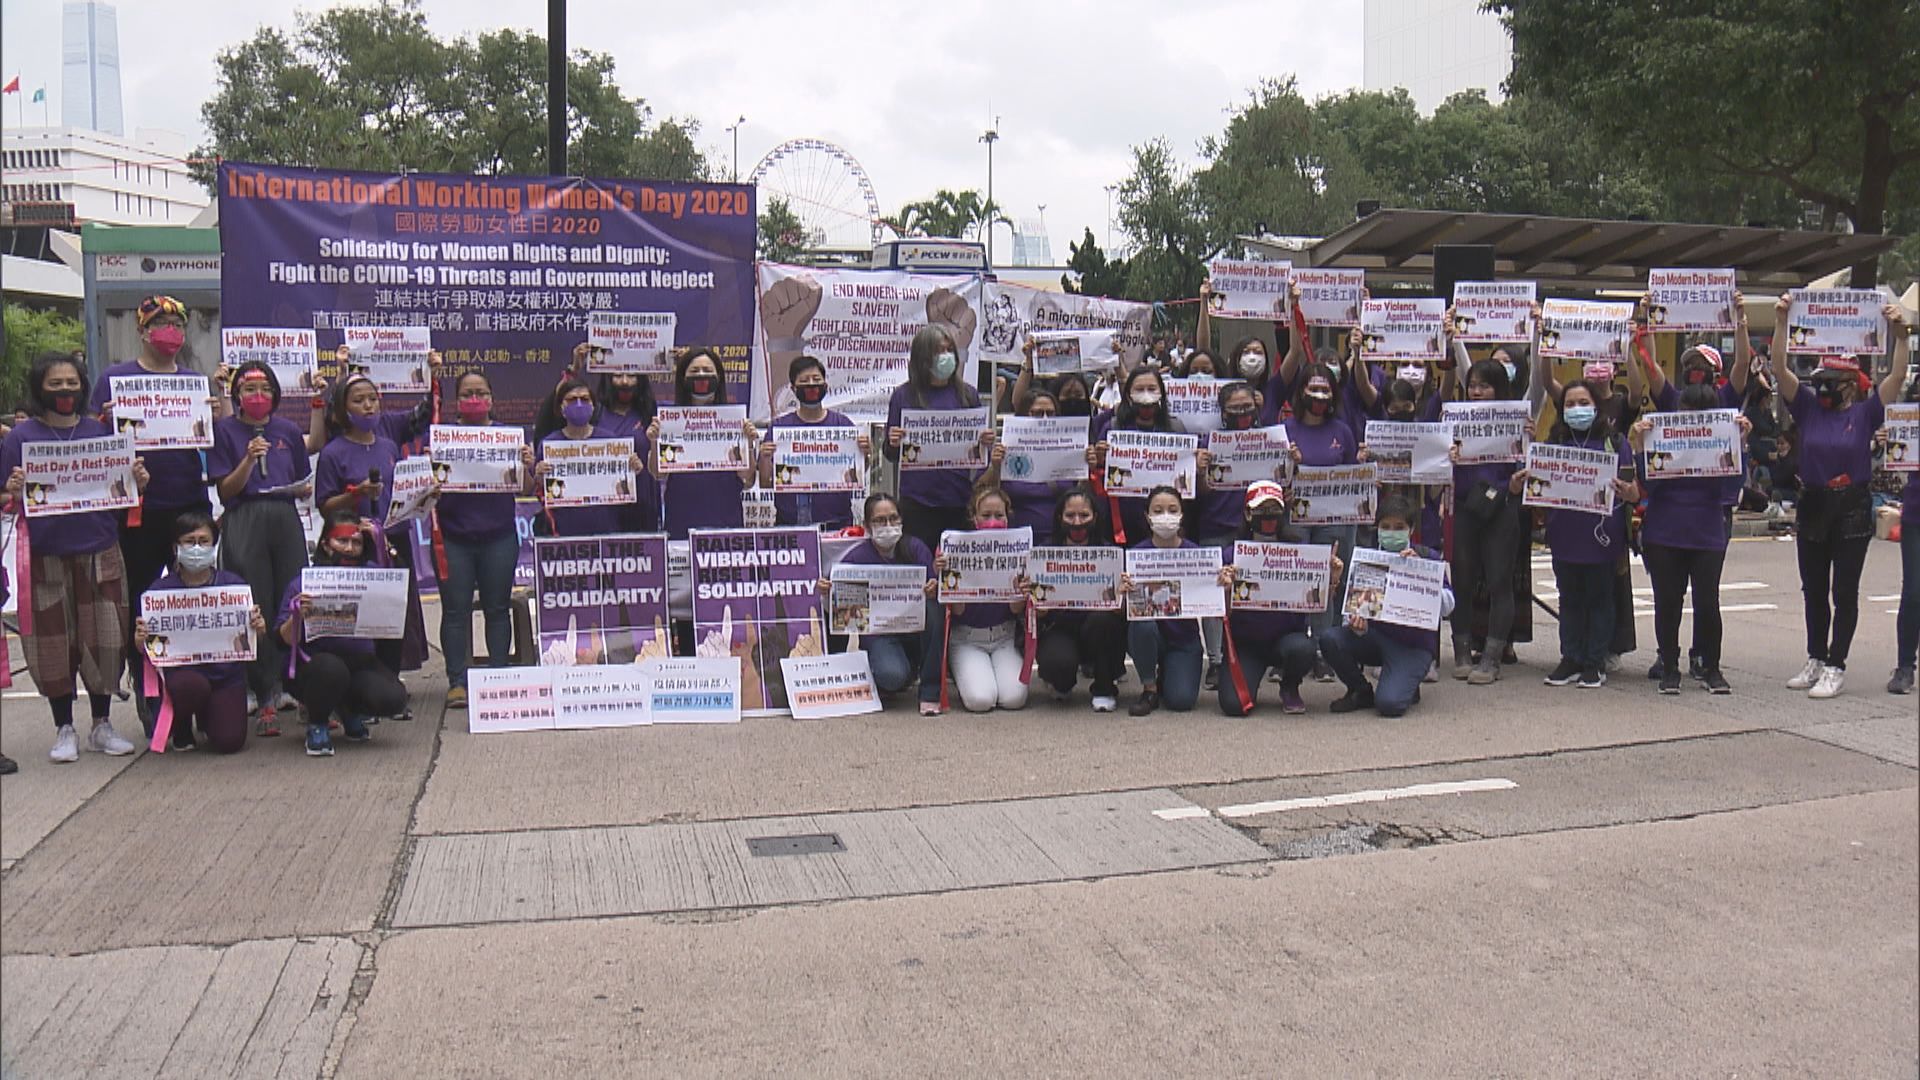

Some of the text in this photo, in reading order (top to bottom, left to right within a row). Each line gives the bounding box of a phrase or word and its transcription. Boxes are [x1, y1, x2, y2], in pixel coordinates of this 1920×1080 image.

[229, 170, 748, 219] International Working Women's Day 2020
[319, 238, 671, 270] Solidarity for Women Rights and Dignity:
[921, 251, 950, 260] PCCW
[159, 261, 220, 271] PAYPHONE
[269, 263, 714, 293] Fight the COVID-19 Threats and Government Neglect
[1651, 273, 1665, 286] Stop
[1666, 272, 1692, 285] Modern
[1692, 272, 1706, 286] Day
[833, 284, 921, 301] END MODERN-DAY
[1365, 300, 1417, 312] Stop Violence
[1808, 304, 1859, 315] Eliminate
[1037, 308, 1046, 319] A
[1049, 309, 1094, 325] migrant
[1098, 318, 1141, 331] woman's
[1797, 316, 1831, 328] Health
[593, 327, 658, 339] Health Services
[811, 318, 898, 336] FIGHT FOR LIVABLE
[226, 331, 254, 349] Living
[255, 332, 282, 349] Wage
[283, 332, 294, 346] for
[348, 329, 404, 341] Stop Violence
[373, 340, 399, 352] Against
[613, 340, 656, 349] for Carers!
[811, 336, 911, 354] STOP DISCRIMINATION
[525, 349, 551, 363] 香港
[725, 347, 747, 357] 2020
[827, 356, 871, 370] VIOLENCE
[873, 357, 885, 370] AT
[1168, 383, 1211, 399] iving Wage
[117, 395, 191, 408] Health Services
[144, 408, 192, 419] for Carers!
[660, 409, 717, 421] Stop Violence
[1445, 410, 1469, 421] Provide
[1470, 408, 1491, 421] Social
[685, 421, 712, 432] Against
[903, 416, 930, 428] Provide
[931, 415, 950, 427] Social
[433, 431, 523, 446] Stop Modern Day Slavery!
[1212, 431, 1267, 445] Stop Violence
[1663, 427, 1712, 439] Eliminate
[792, 442, 839, 453] Eliminate
[1654, 439, 1686, 451] Health
[783, 454, 814, 465] Health
[1111, 447, 1178, 461] Health Services
[27, 456, 130, 474] Rest Day & Rest Space
[1131, 460, 1176, 471] for Carers!
[1531, 459, 1598, 476] Health Services
[57, 471, 108, 485] for Carers!
[1550, 473, 1562, 481] for
[697, 534, 798, 553] RAISE THE
[944, 540, 970, 554] Provide
[971, 540, 993, 554] Social
[542, 541, 648, 561] RAISE THE
[1237, 544, 1299, 558] Stop Violence
[696, 549, 806, 569] VIBRATION
[1263, 557, 1328, 571] Against Women!
[541, 556, 652, 578] VIBRATION
[1047, 561, 1096, 573] Eliminate
[543, 572, 616, 593] RISE IN
[699, 566, 771, 585] RISE IN
[1036, 574, 1069, 585] Health
[698, 580, 816, 600] SOLIDARITY
[145, 592, 219, 613] Stop Modern Day
[543, 588, 664, 609] SOLIDARITY
